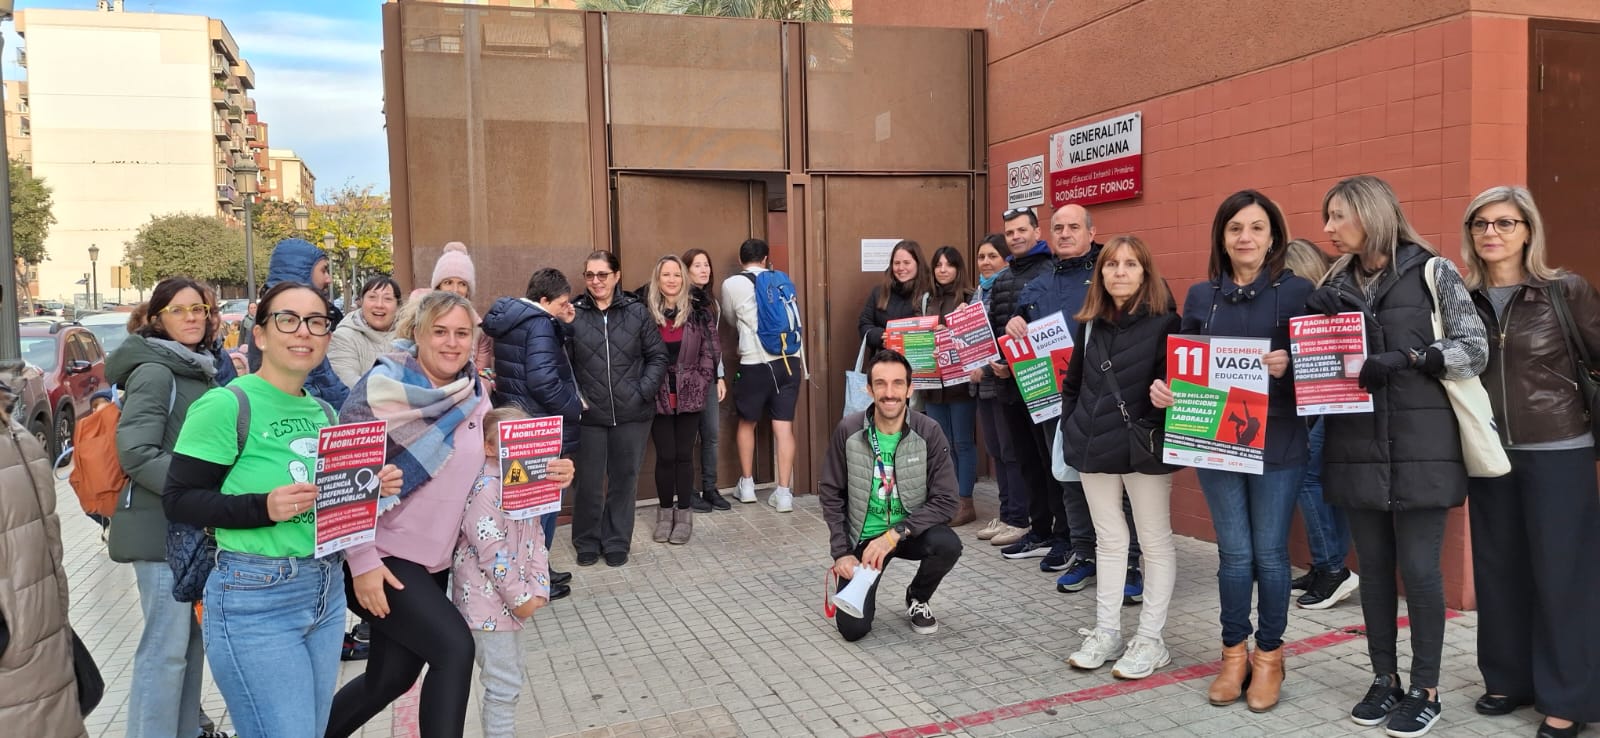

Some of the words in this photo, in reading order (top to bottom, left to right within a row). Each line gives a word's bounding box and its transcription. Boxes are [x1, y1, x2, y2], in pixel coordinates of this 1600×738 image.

[1070, 118, 1135, 146] GENERALITAT
[1069, 139, 1129, 164] VALENCIANA
[1093, 169, 1111, 180] Infantil
[1055, 184, 1098, 202] RODRÍGUEZ
[1100, 178, 1135, 195] FORNOS
[946, 316, 953, 326] 7
[1032, 325, 1064, 343] VAGA
[1292, 322, 1302, 336] 7
[1303, 324, 1362, 335] MOBILITZACIÓ
[1036, 335, 1067, 350] EDUCATIVA
[1216, 347, 1263, 355] DESEMBRE
[1174, 346, 1203, 376] 11
[1215, 357, 1262, 370] VAGA
[1215, 372, 1263, 380] EDUCATIVA
[1296, 372, 1336, 380] PROFESSORAT
[1172, 406, 1212, 415] SALARIALS
[1172, 415, 1209, 423] LABORALS
[332, 428, 355, 438] RAONS
[356, 427, 370, 435] PER
[376, 425, 384, 433] LA
[502, 425, 512, 438] 7
[512, 427, 560, 438] MOBILITZACIÓ
[322, 432, 332, 450] 7
[330, 433, 385, 449] MOBILITZACIÓ
[317, 459, 325, 470] 6
[317, 473, 346, 484] DEFENSAR
[323, 478, 351, 490] VALENCIÀ
[323, 487, 353, 499] DEFENSAR
[317, 498, 341, 509] L'ESCOLA
[341, 492, 366, 504] PÚBLICA
